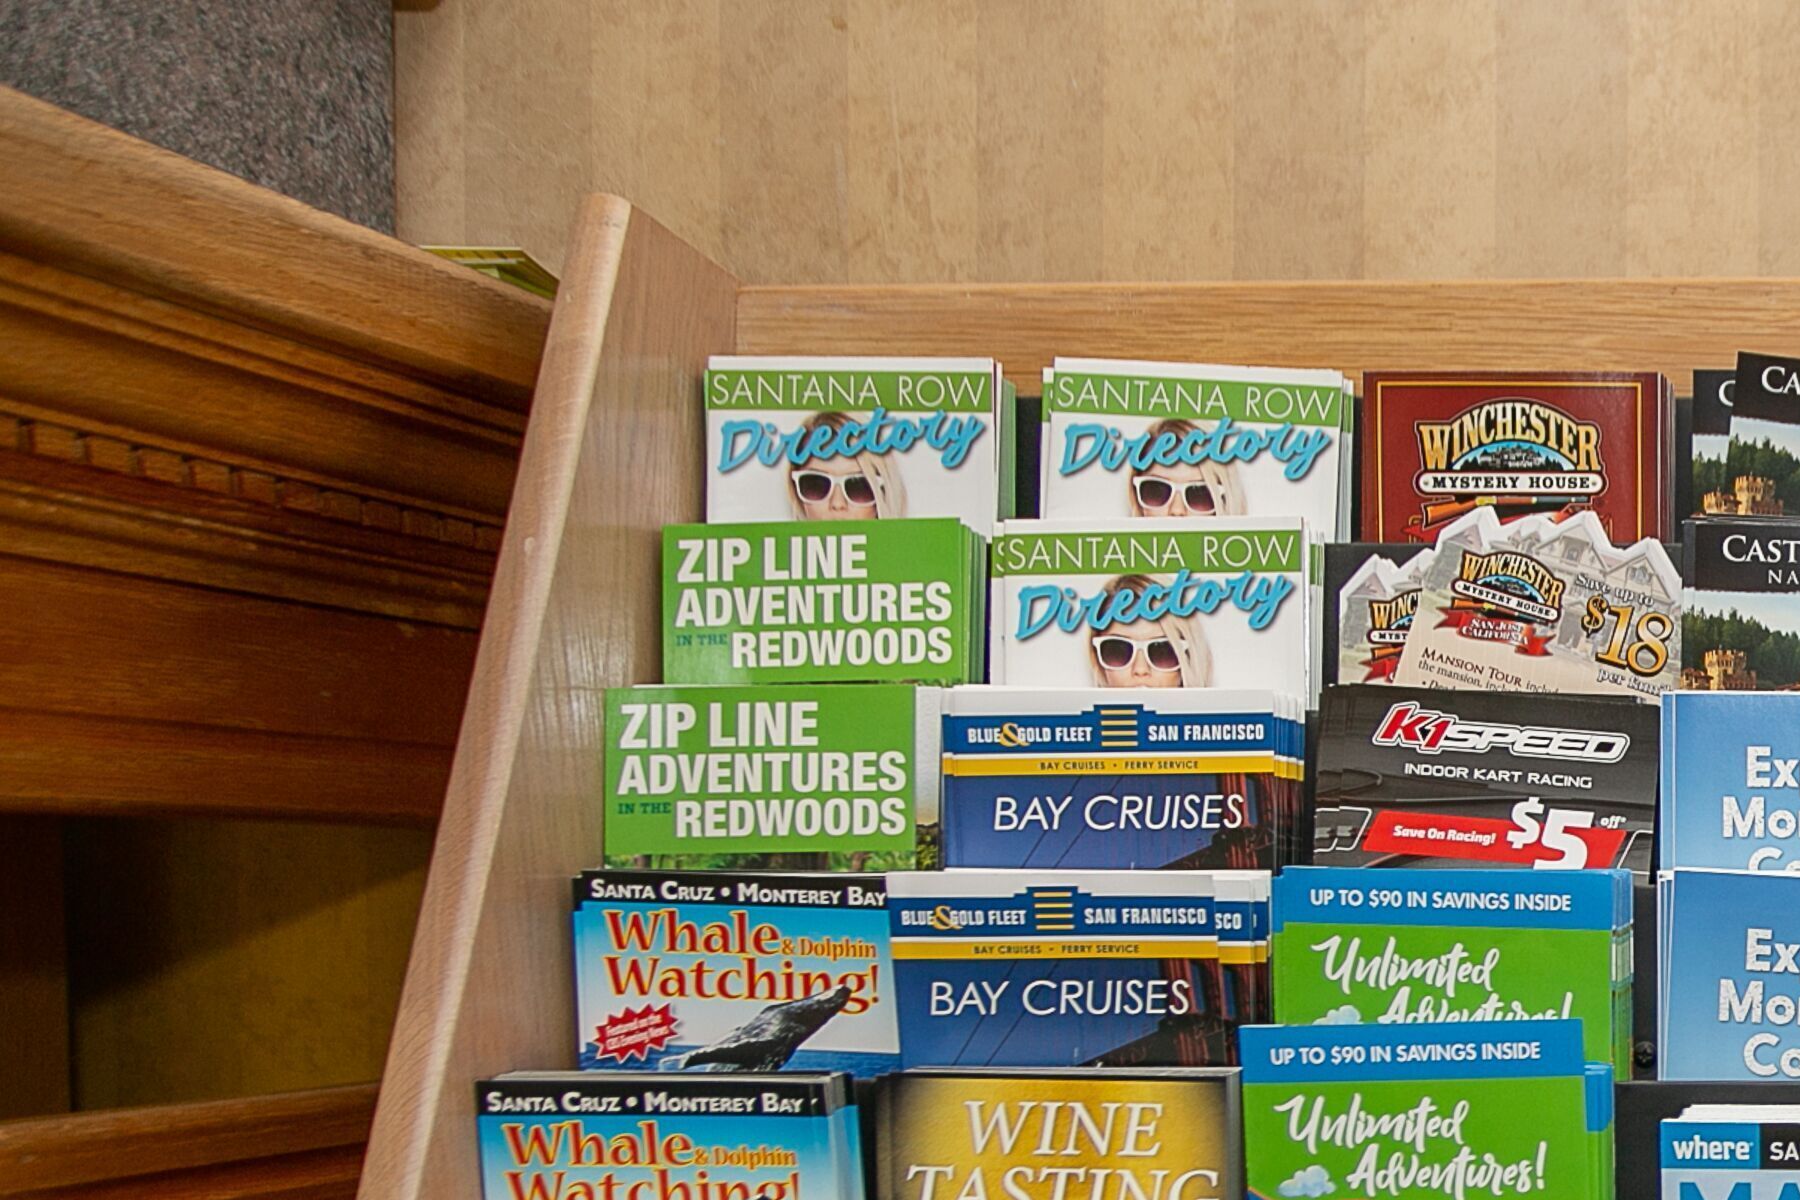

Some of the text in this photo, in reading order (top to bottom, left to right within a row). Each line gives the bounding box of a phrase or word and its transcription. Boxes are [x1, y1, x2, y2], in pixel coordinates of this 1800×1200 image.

[711, 374, 986, 408] SANTANA ROW
[717, 409, 984, 473] Directory
[1417, 401, 1602, 472] WINCHESTER
[1432, 474, 1591, 490] MYSTERY HOUSE
[676, 534, 867, 583] ZIP LINE
[675, 581, 952, 628] ADVENTURES
[732, 626, 952, 668] REDWOODS
[1148, 723, 1264, 741] SAN FRANCISCO
[1405, 763, 1592, 789] INDOOR KART RACING
[994, 794, 1243, 831] BAY CRUISES
[1393, 826, 1496, 845] Save On Racing!
[964, 1100, 1163, 1157] WINE
[1273, 1093, 1470, 1156] Unlimited
[1672, 1137, 1751, 1161] where
